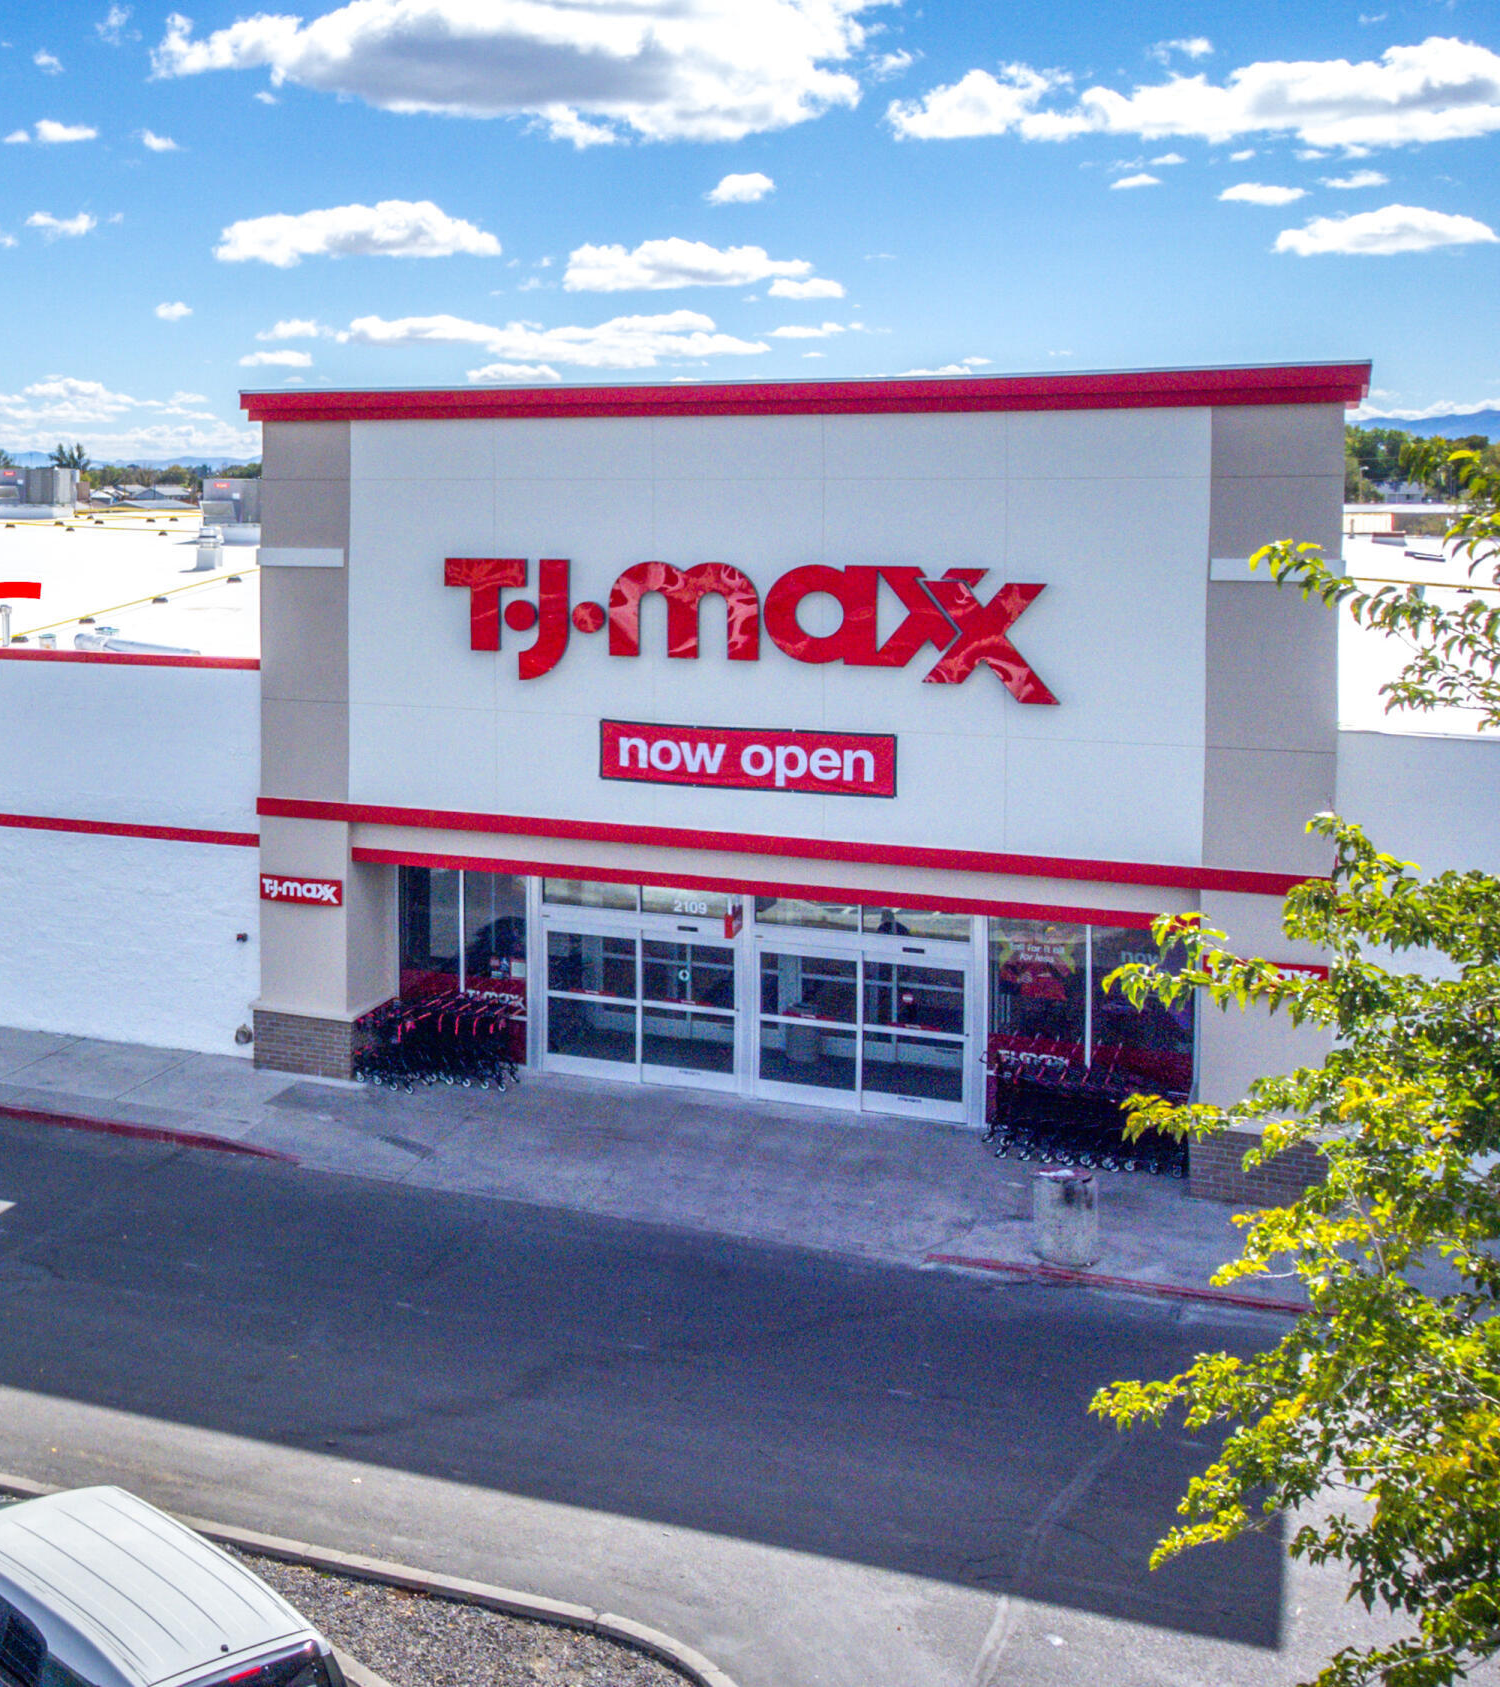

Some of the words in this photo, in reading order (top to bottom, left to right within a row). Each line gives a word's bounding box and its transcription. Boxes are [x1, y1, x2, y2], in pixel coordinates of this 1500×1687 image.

[618, 735, 726, 774] now
[740, 744, 875, 787] open
[673, 900, 708, 915] 2109
